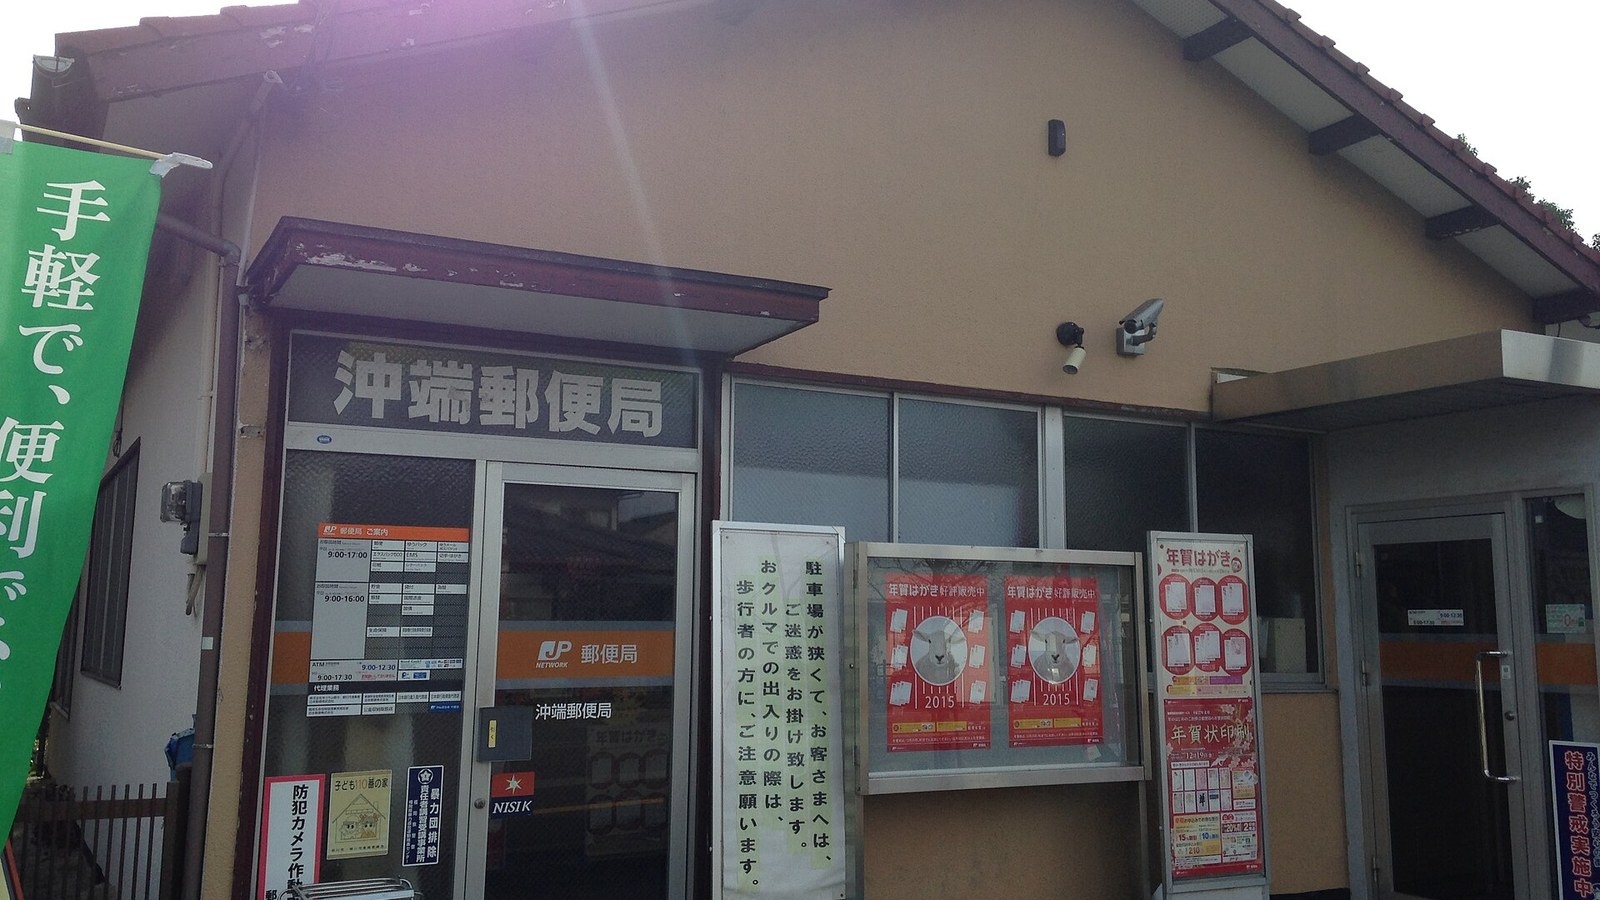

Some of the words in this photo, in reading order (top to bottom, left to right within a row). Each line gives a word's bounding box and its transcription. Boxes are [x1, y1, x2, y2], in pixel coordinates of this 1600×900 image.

[333, 350, 662, 437] 沖端郵便局
[366, 528, 389, 536] ご案内
[328, 551, 368, 559] 9:00-17:00
[1166, 548, 1231, 567] 年賀はがき
[324, 595, 365, 603] 9:00-16:00
[580, 644, 638, 664] 郵便局
[535, 661, 568, 669] NETWORK
[760, 559, 784, 822] おクルマでの出入りの際は、
[1042, 693, 1071, 706] 2015
[534, 702, 612, 720] 沖端郵便局
[805, 560, 832, 861] 駐車場が狭くて、お客さまへは、
[924, 695, 956, 709] 2015
[736, 579, 759, 886] 歩行者の方に、ご注意願います。
[784, 603, 807, 848] ご迷惑をお掛け致します。
[1170, 722, 1250, 745] 年賀状印刷
[492, 800, 533, 814] NISIK
[426, 787, 440, 859] 暴力団排除
[1564, 750, 1593, 898] 特別警戒実施中
